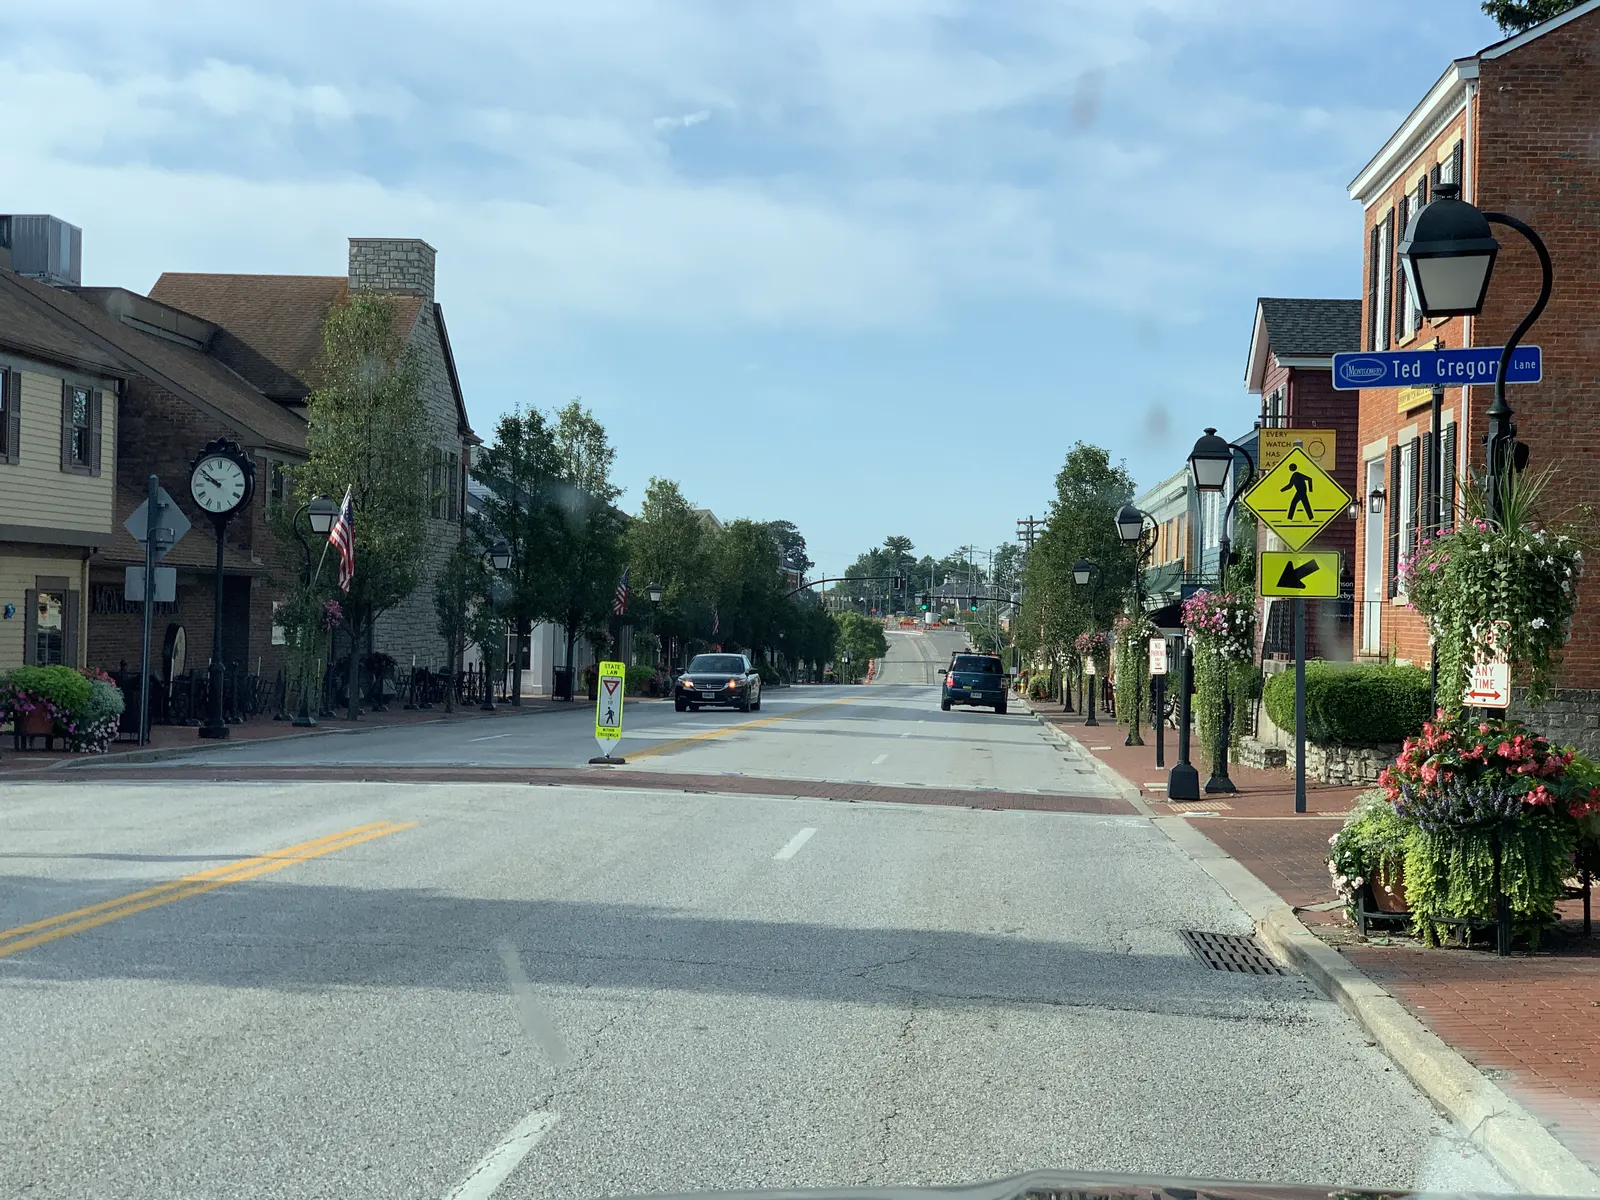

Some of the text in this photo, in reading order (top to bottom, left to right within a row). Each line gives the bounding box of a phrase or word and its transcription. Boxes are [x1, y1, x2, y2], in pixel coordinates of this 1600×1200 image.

[1348, 365, 1382, 377] MONTGOMERY
[1392, 359, 1421, 378] Ted
[1514, 359, 1536, 370] Lane
[1474, 665, 1495, 677] ANY
[1473, 678, 1496, 690] TIME
